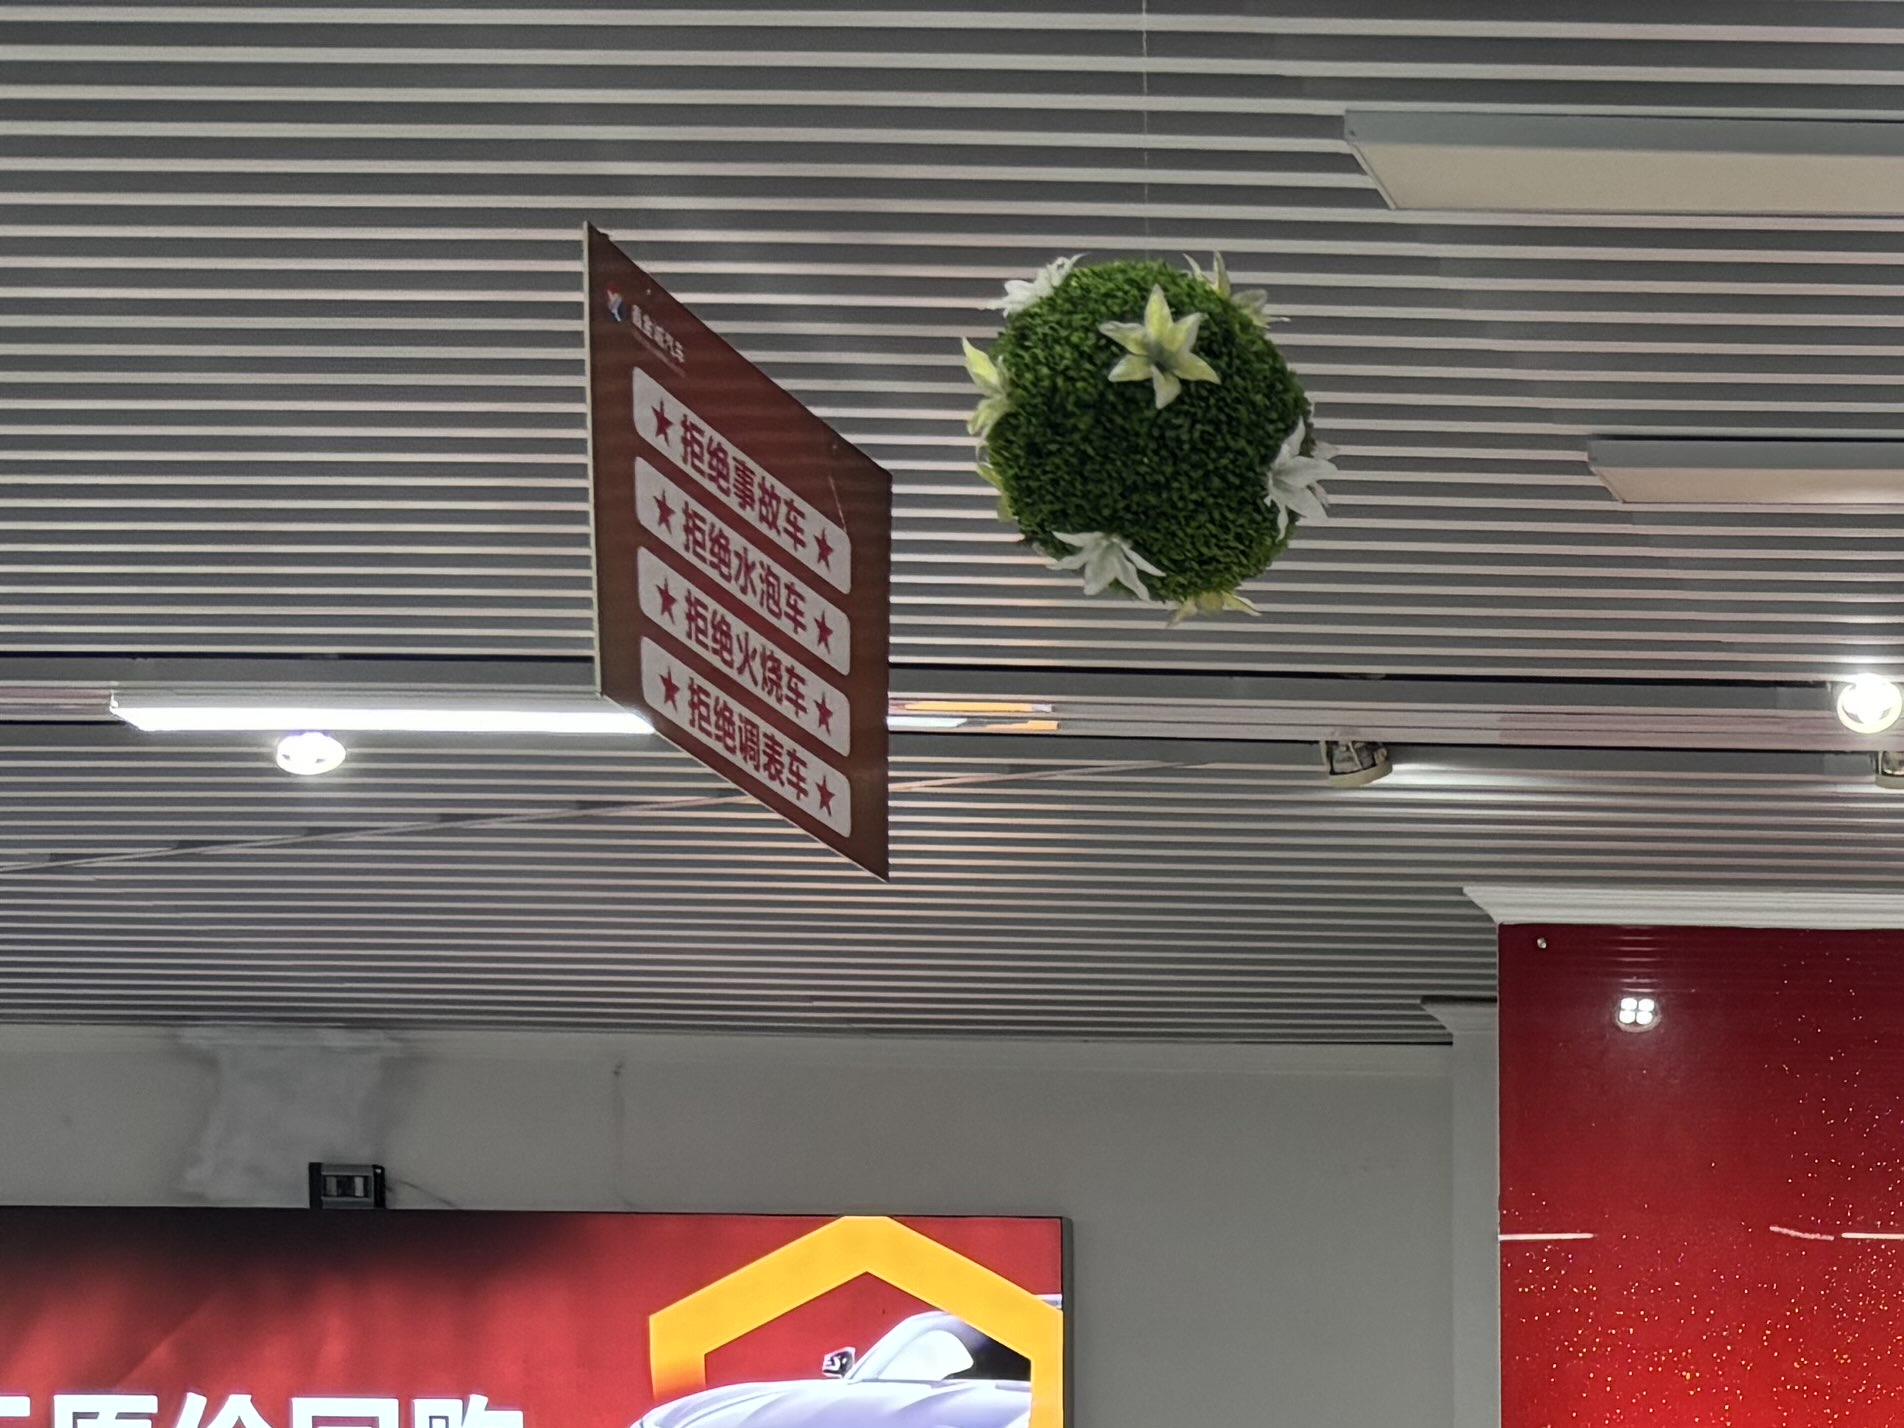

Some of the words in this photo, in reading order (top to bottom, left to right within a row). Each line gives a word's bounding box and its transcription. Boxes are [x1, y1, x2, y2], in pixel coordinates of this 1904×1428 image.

[680, 413, 807, 551] 拒绝事故车
[681, 500, 807, 635] 拒绝水泡车
[683, 595, 808, 718] 拒绝火烧车
[687, 677, 810, 802] 拒绝调表车
